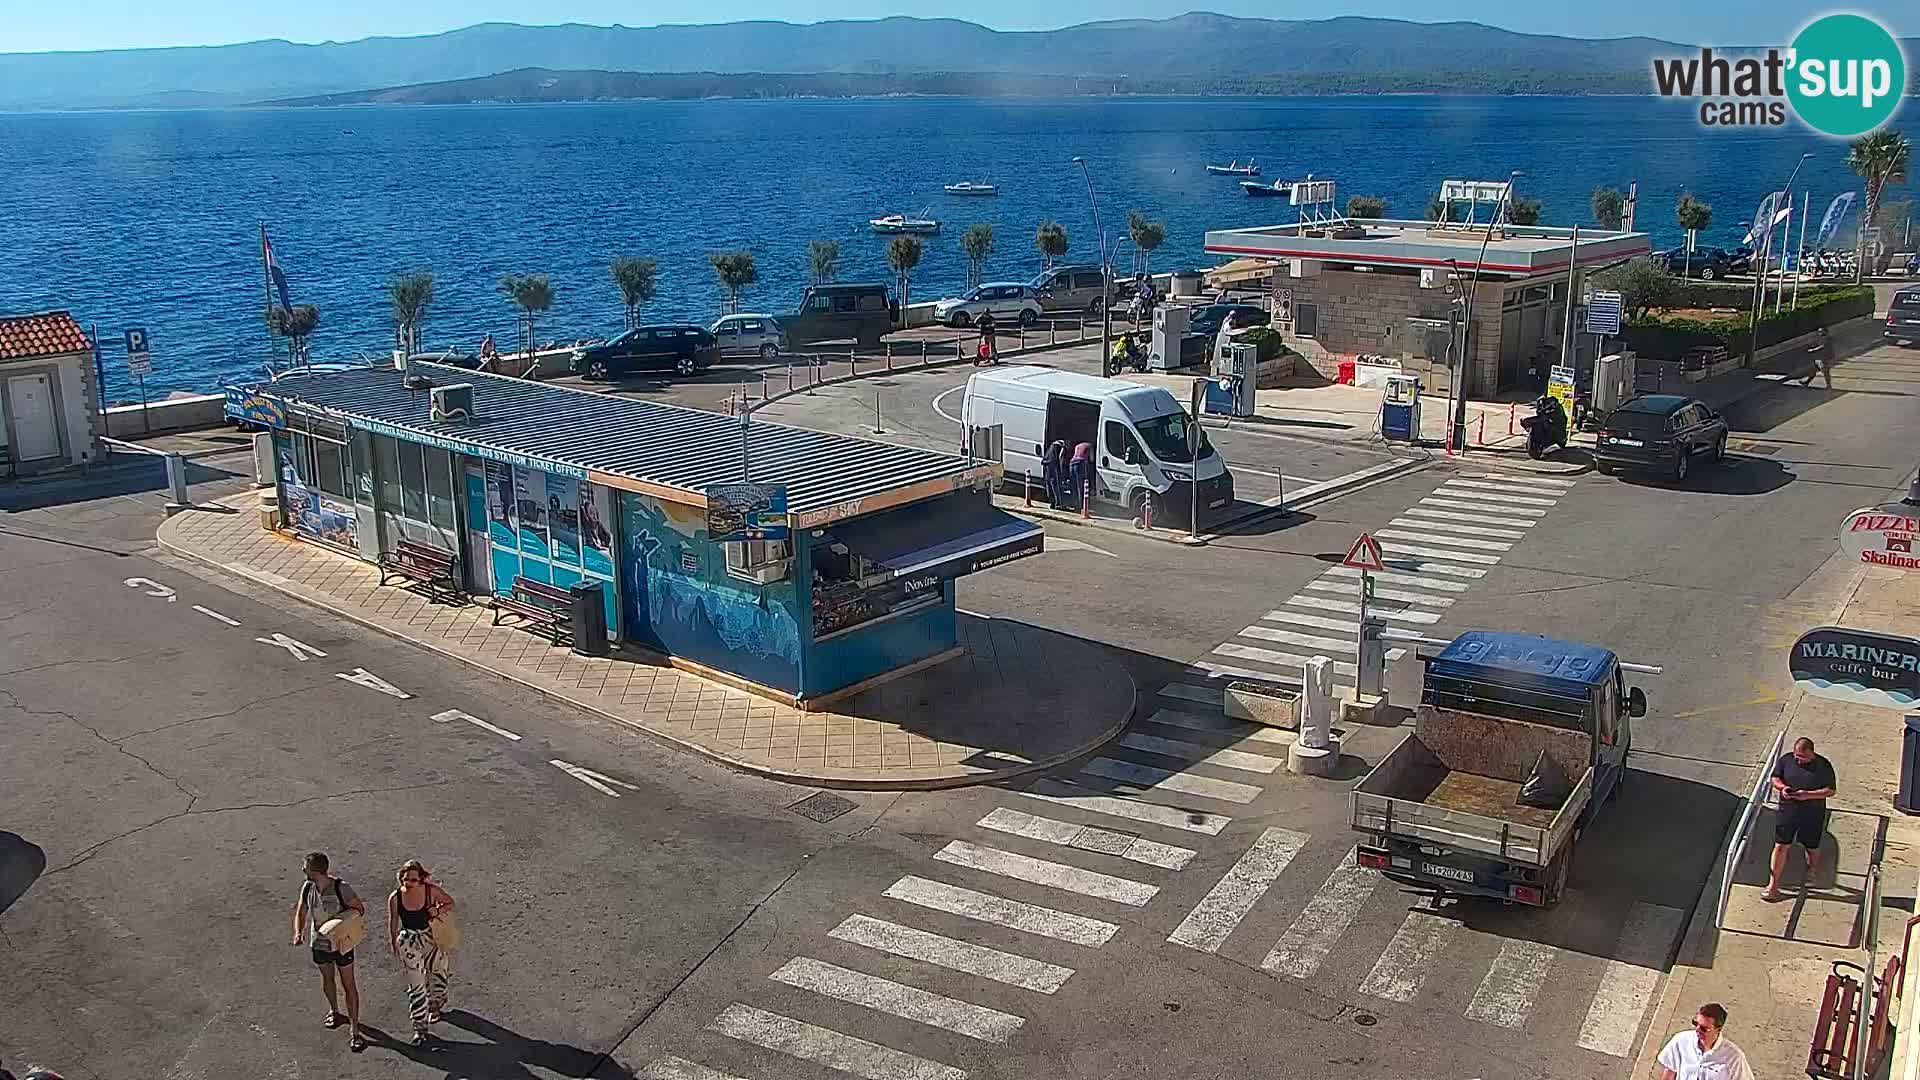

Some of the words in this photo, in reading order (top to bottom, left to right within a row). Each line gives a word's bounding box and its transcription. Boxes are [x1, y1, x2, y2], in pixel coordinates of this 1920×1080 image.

[130, 331, 143, 350] P
[437, 438, 468, 453] POSTAJA
[478, 447, 493, 458] BUS
[494, 450, 526, 466] STATION
[528, 458, 554, 472] TICKET
[555, 463, 583, 478] OFFICE
[1801, 642, 1920, 673] MARINER
[1829, 662, 1867, 676] caffe
[1871, 666, 1899, 680] bar
